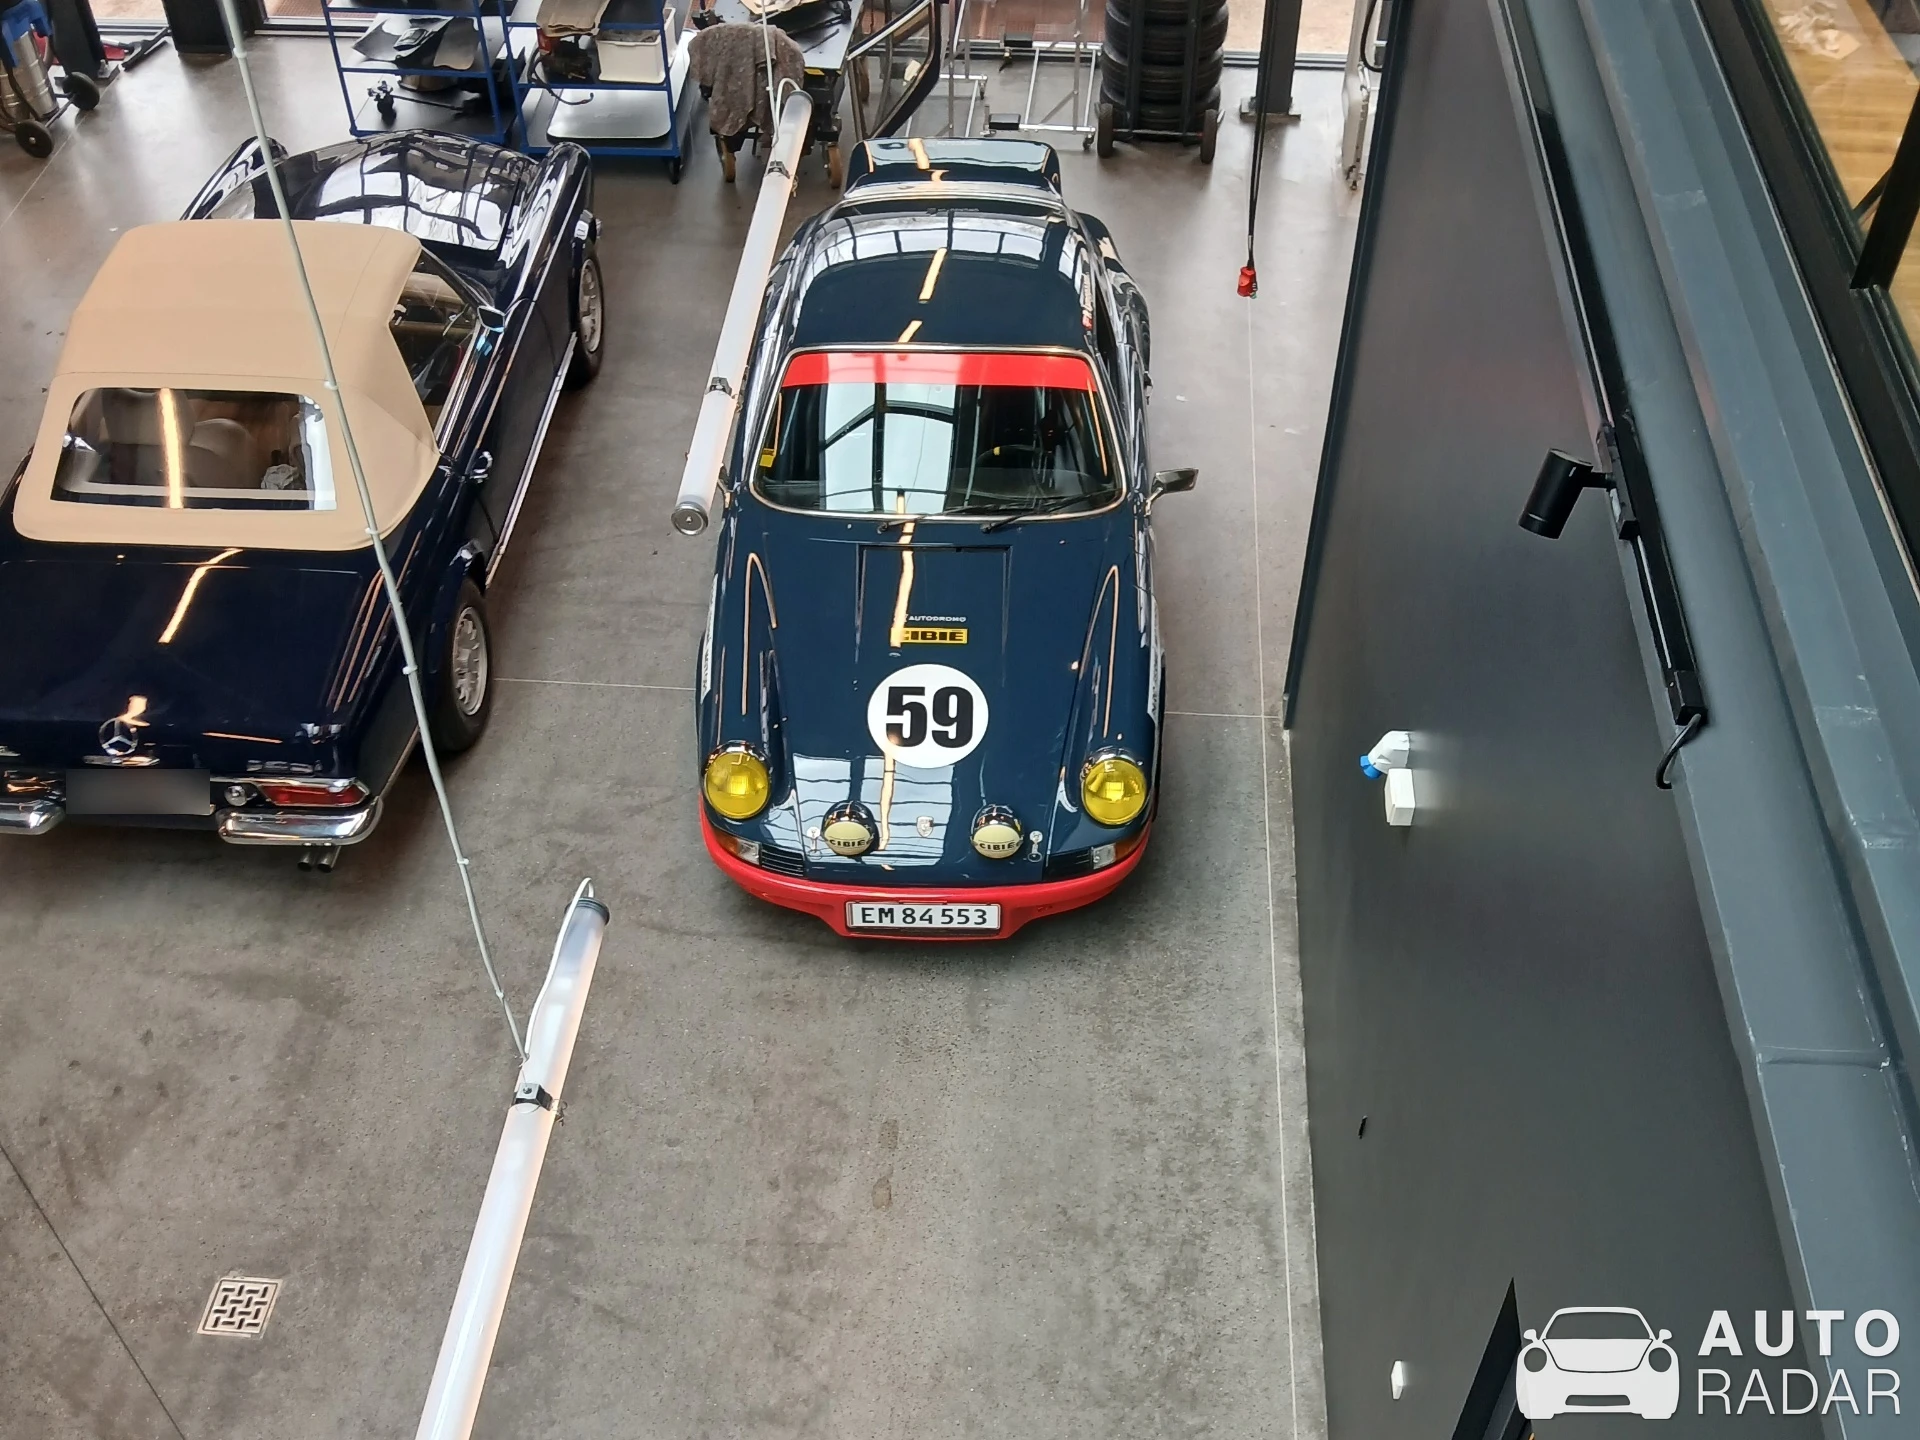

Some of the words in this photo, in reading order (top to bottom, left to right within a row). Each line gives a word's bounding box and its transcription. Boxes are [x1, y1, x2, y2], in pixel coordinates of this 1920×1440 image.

[885, 686, 974, 749] 59
[861, 907, 895, 925] EM
[902, 907, 933, 925] 84
[940, 908, 987, 926] 553
